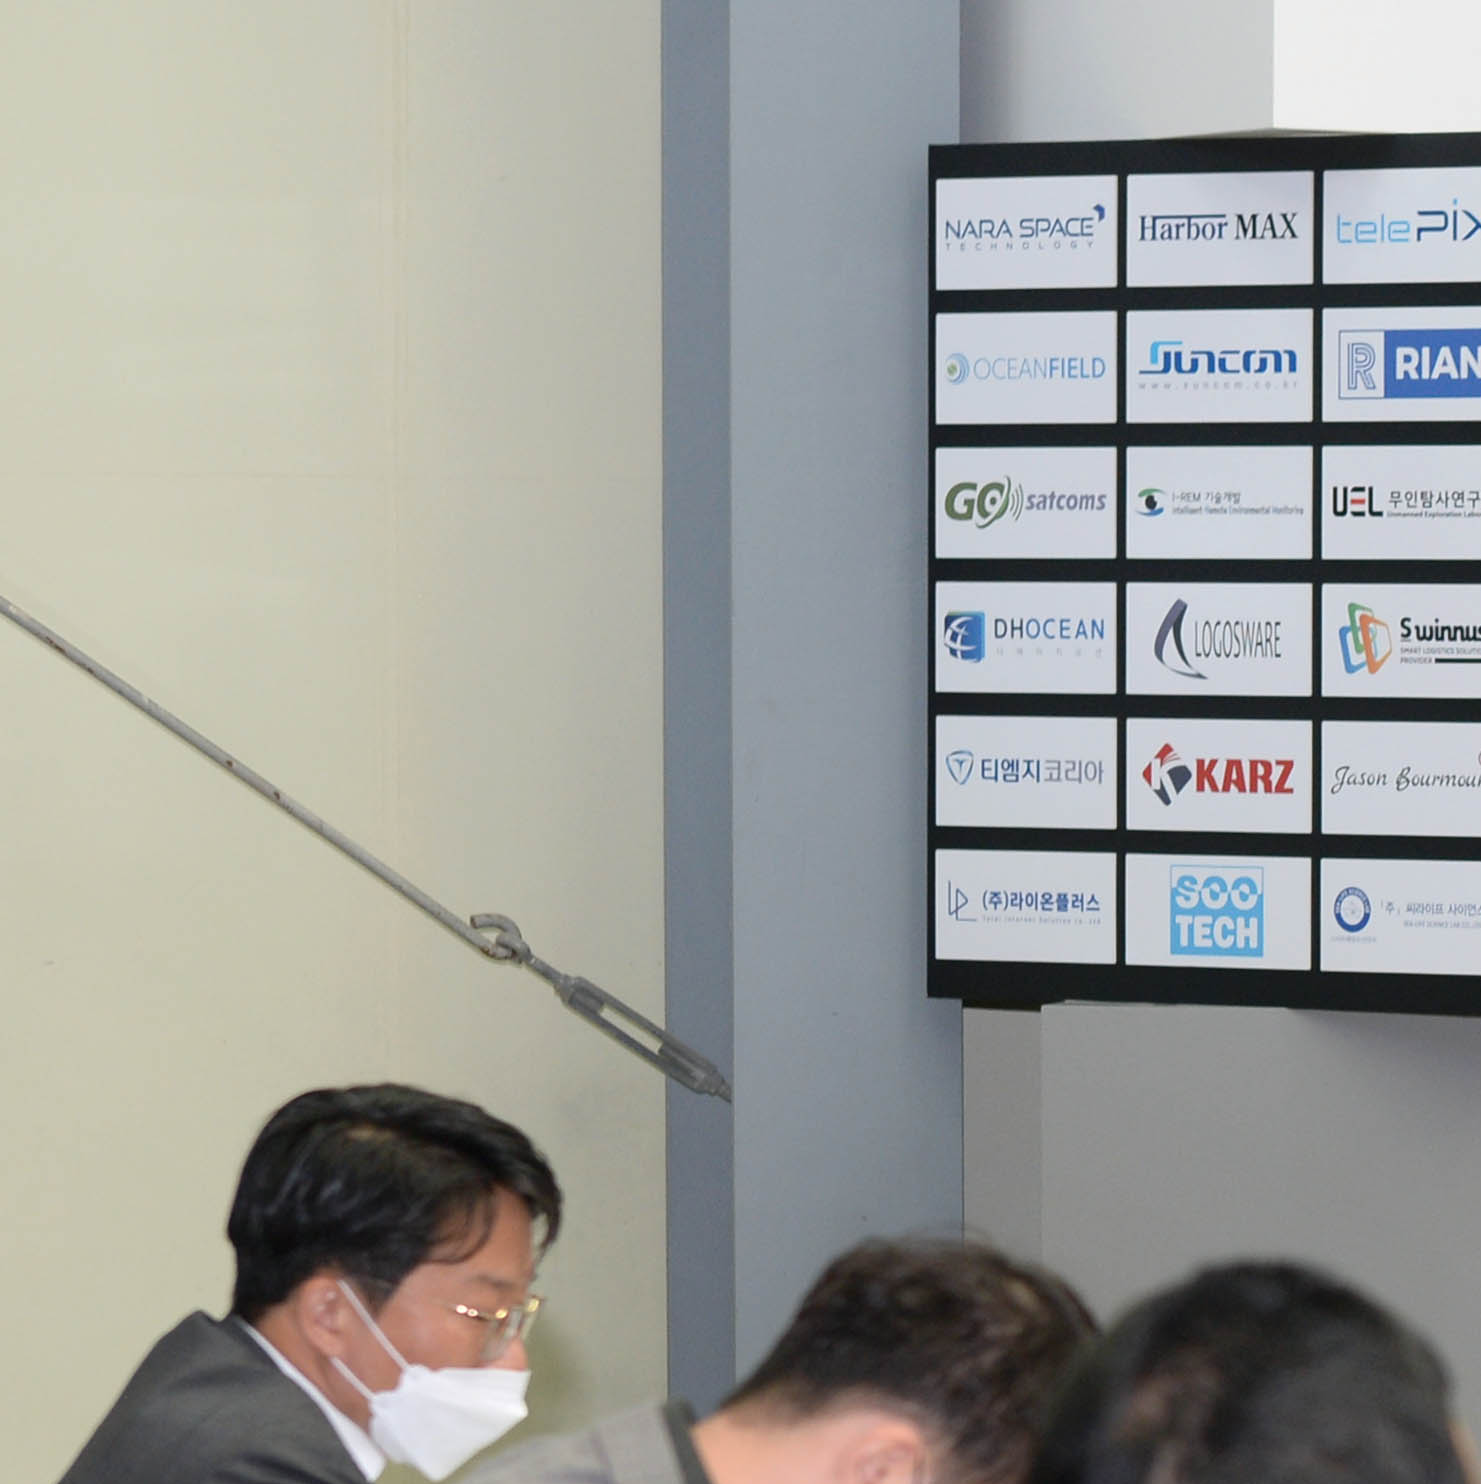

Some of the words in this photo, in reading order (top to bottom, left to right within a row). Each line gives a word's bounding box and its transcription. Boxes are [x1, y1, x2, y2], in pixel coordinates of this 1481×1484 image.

[945, 217, 1013, 239] NARA
[1019, 216, 1095, 238] SPACE
[1138, 213, 1229, 242] Harbor
[1234, 212, 1300, 241] MAX
[946, 240, 1095, 252] TECHNOLOGY
[973, 356, 1107, 381] OCEANFIELD
[1333, 486, 1384, 518] UEL
[993, 617, 1106, 640] DHOCEAN
[1194, 620, 1282, 659] LOGOSWARE
[980, 757, 1105, 786] 티엠지코리아
[1195, 758, 1295, 794] KARZ
[1330, 765, 1388, 795] Jason
[982, 889, 1101, 912] (주)라이온플러스
[1174, 874, 1259, 911] SOO
[1174, 914, 1258, 949] TECH
